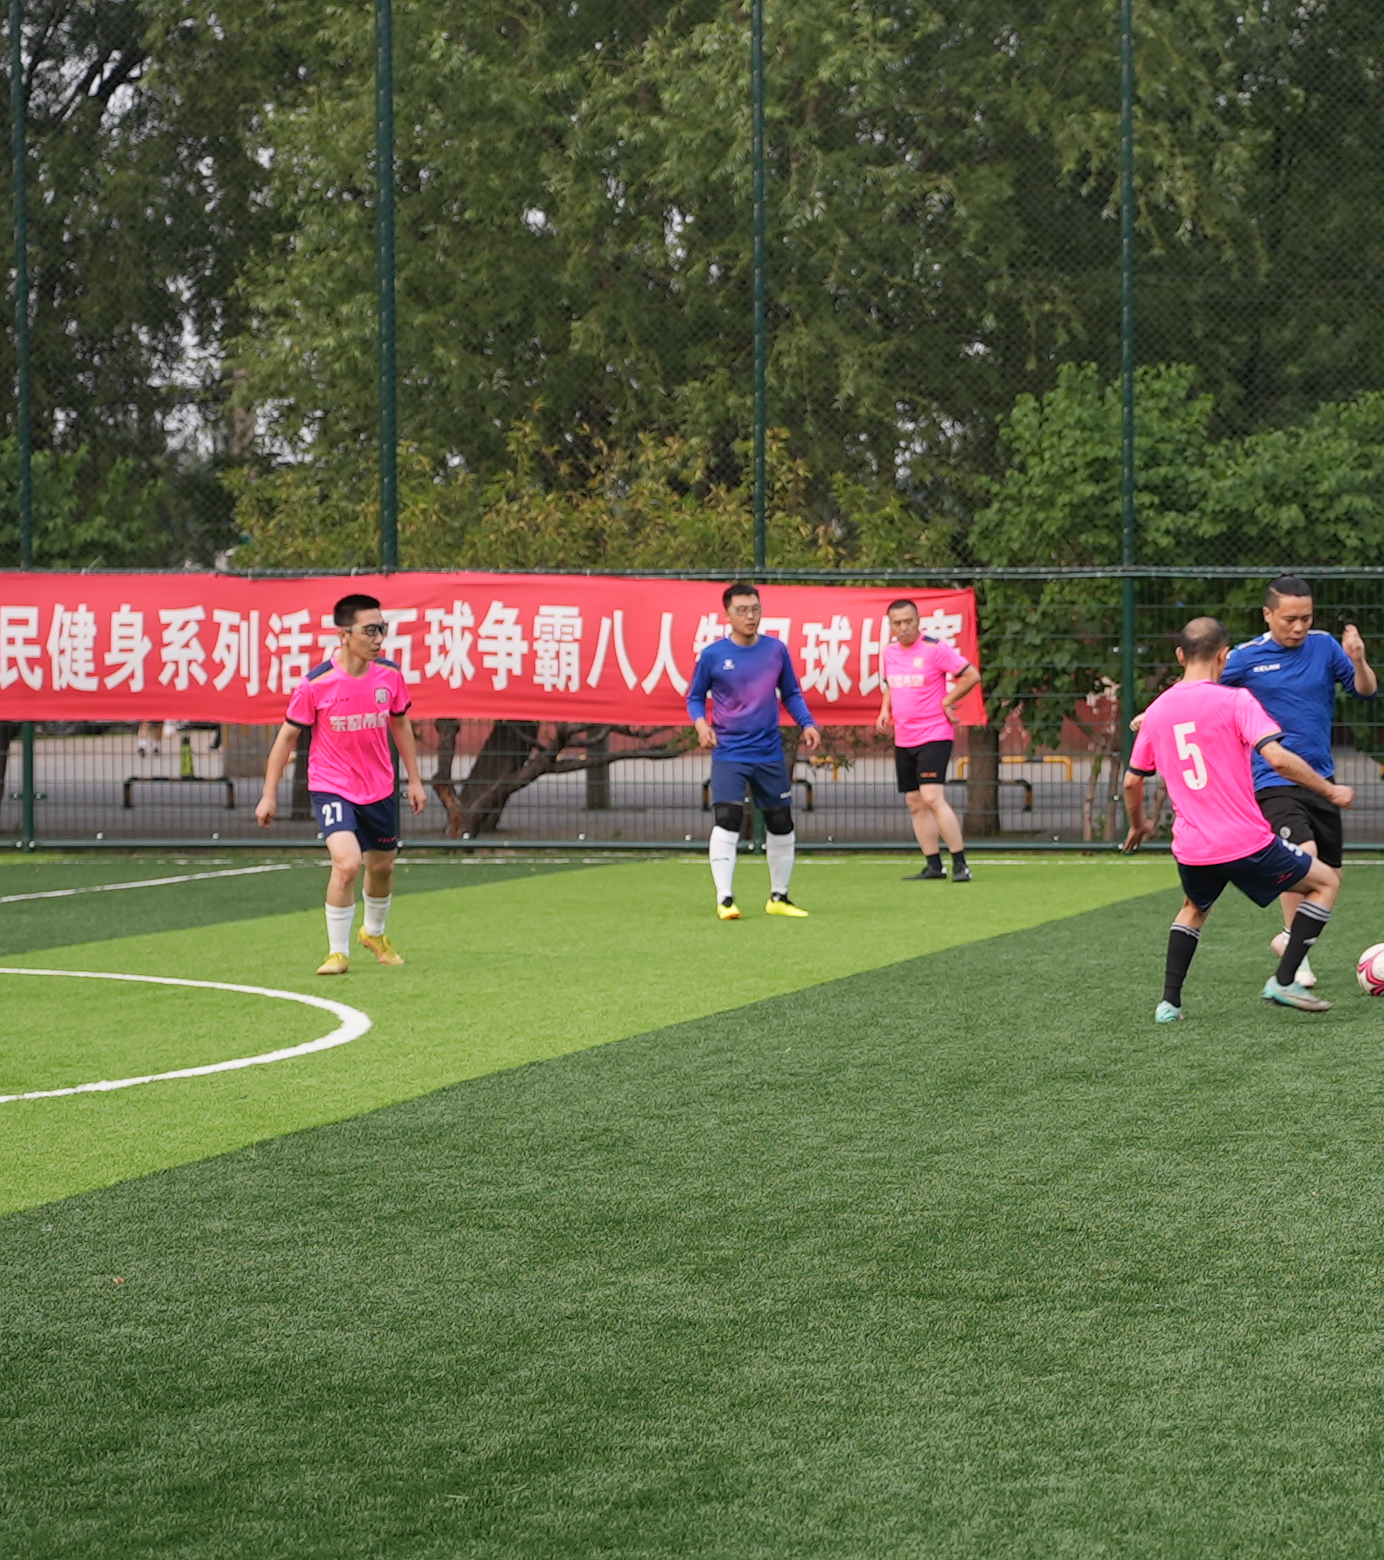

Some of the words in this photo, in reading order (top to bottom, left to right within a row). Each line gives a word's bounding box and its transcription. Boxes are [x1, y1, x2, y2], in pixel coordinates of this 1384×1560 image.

[0, 600, 963, 702] 民健身系列活五球争霸八人球比赛
[1173, 721, 1208, 791] 5
[321, 801, 343, 827] 27
